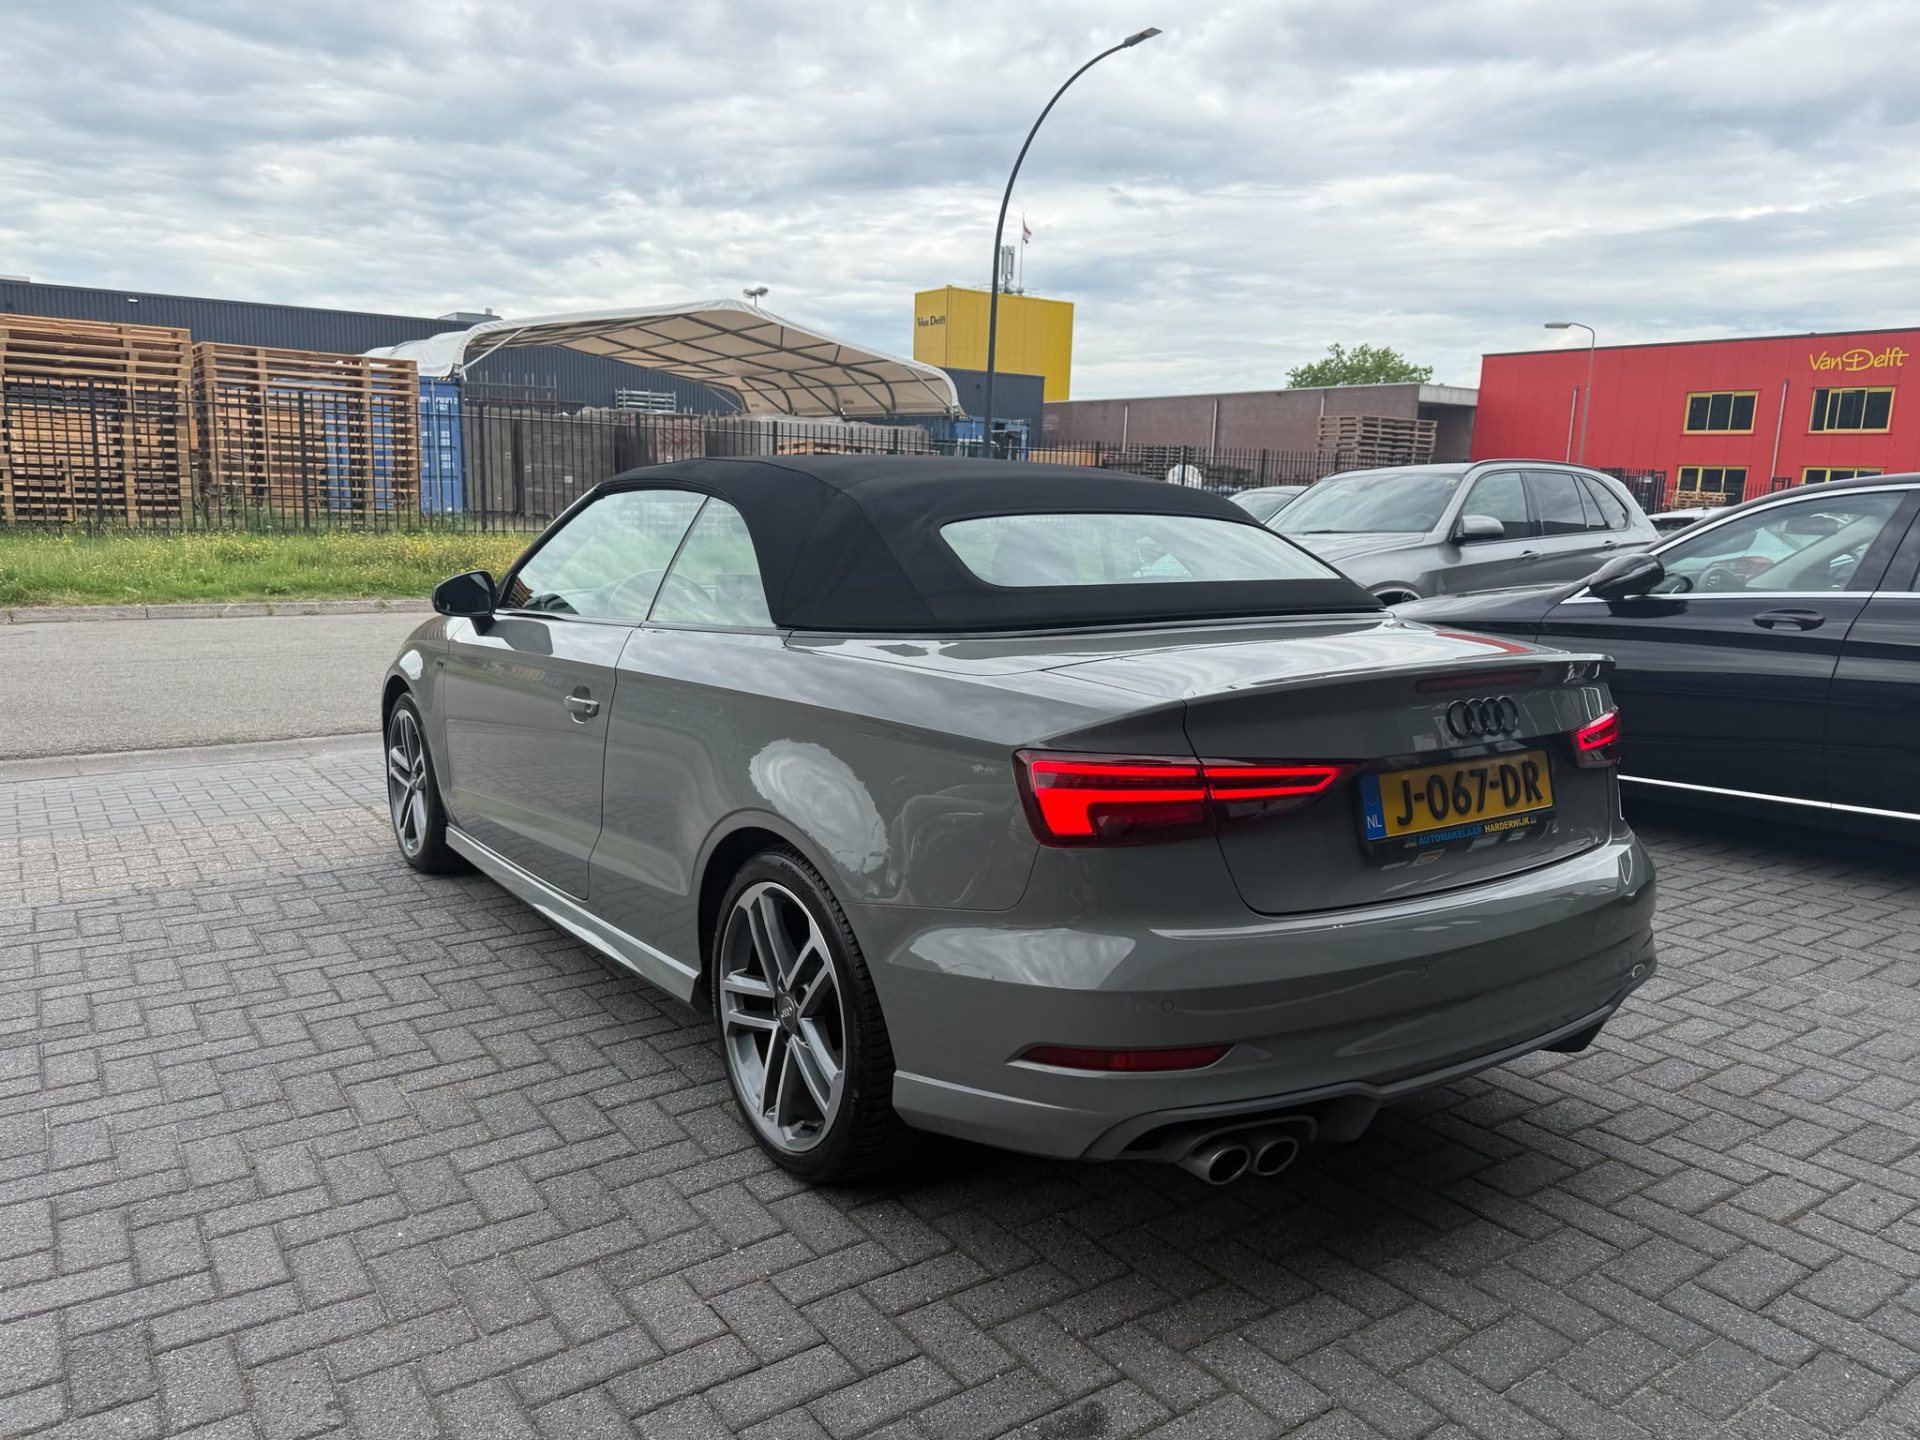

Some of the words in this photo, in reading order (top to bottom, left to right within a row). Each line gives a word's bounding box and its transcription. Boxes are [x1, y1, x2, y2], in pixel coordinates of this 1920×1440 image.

[1397, 761, 1543, 826] J-067-DR
[1367, 814, 1382, 828] NL
[1419, 826, 1482, 845] AUTOMAKELAAR
[1484, 817, 1530, 833] HARDERWIJK
